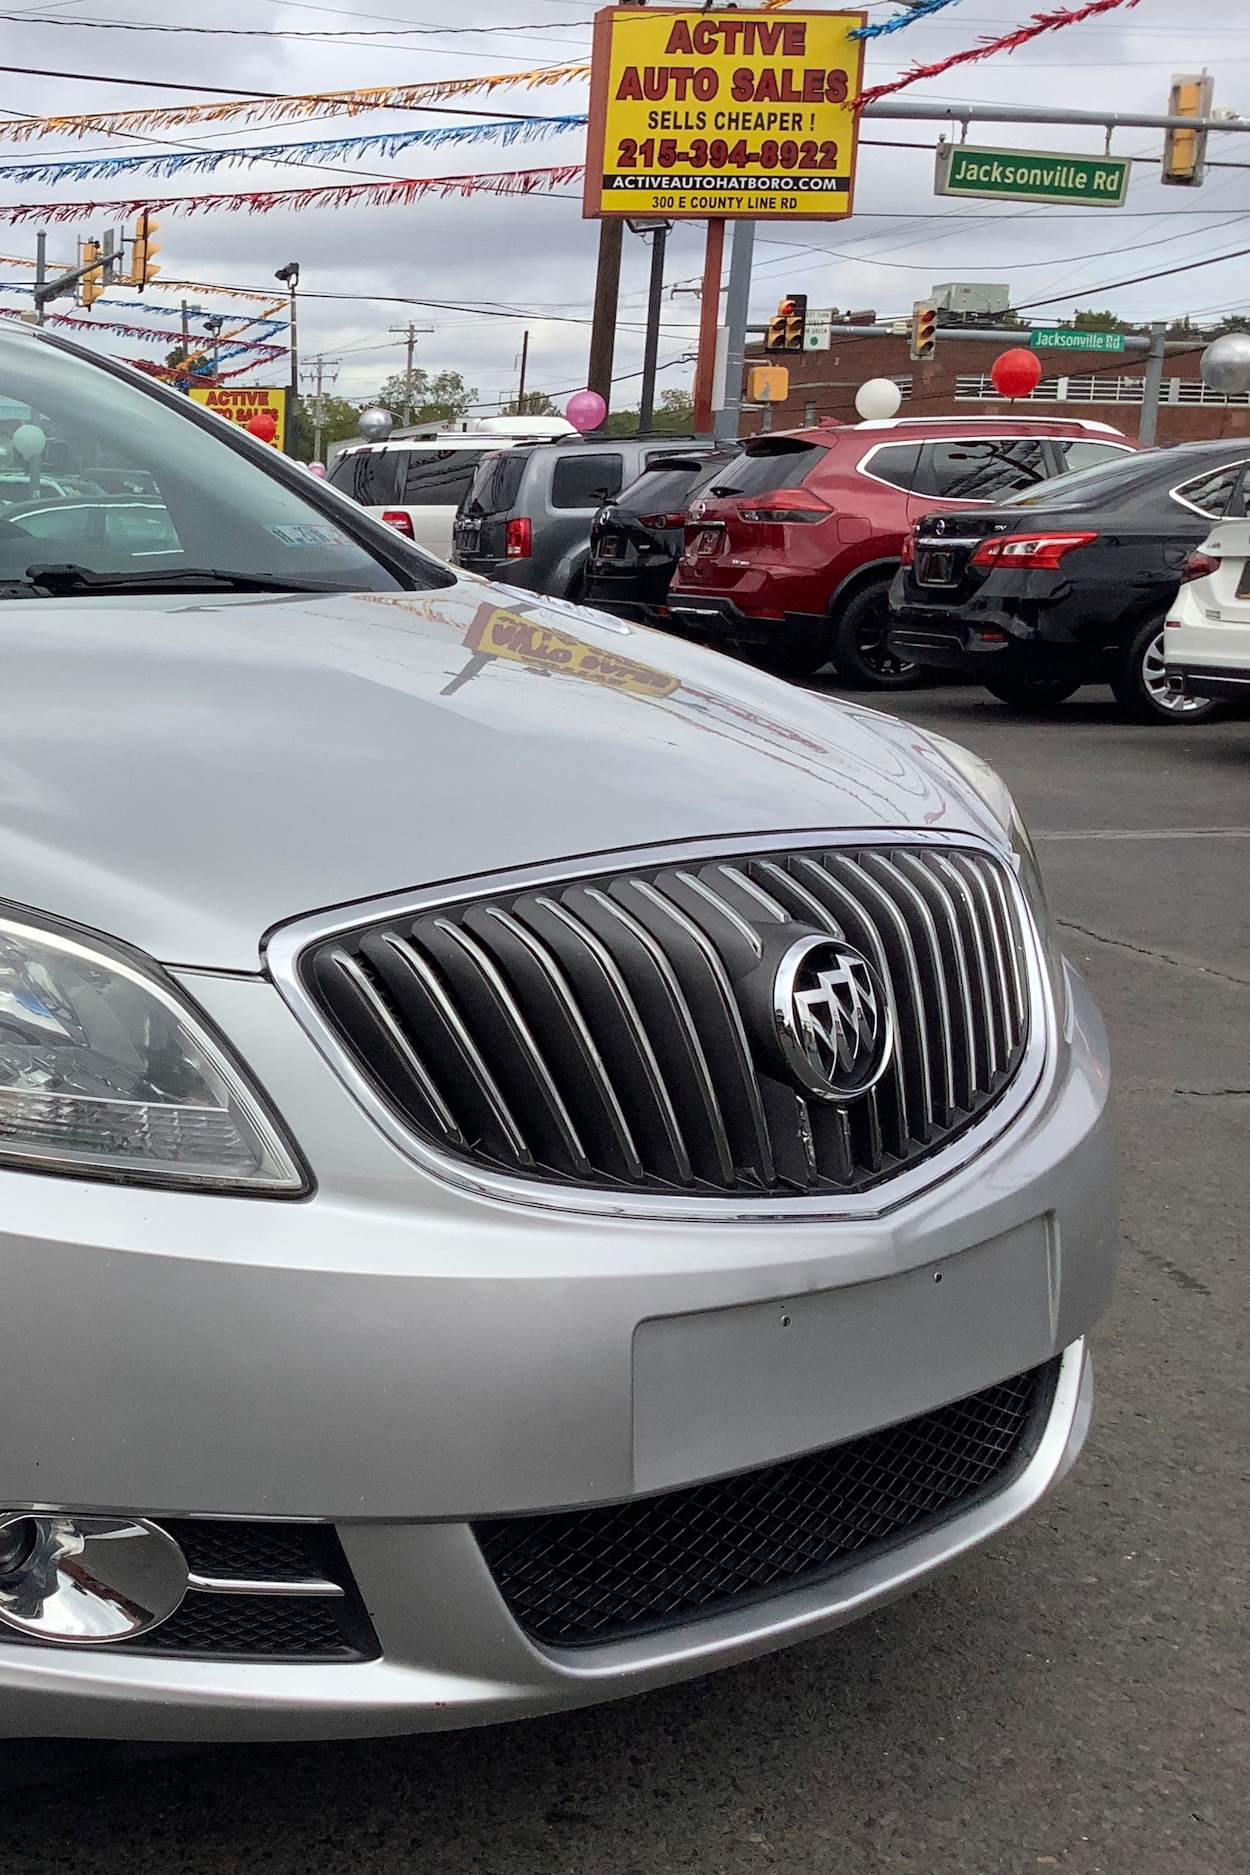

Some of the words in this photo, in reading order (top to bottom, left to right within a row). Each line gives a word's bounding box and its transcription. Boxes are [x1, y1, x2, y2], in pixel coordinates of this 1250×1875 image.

[664, 20, 807, 56] ACTIVE
[615, 66, 719, 102] AUTO
[730, 67, 849, 103] SALES
[648, 111, 707, 130] SELLS
[714, 111, 803, 131] CHEAPER
[810, 113, 816, 131] !
[616, 138, 838, 170] 215-394-8922
[612, 176, 837, 190] ACTIVEAUTOHATBORO.COM
[955, 160, 1088, 189] Jacksonville
[1093, 170, 1120, 192] Rd
[652, 196, 674, 208] 300
[678, 197, 686, 209] E
[690, 197, 743, 209] COUNTY
[747, 197, 777, 209] LINE
[780, 197, 797, 209] RD
[1035, 332, 1103, 348] Jacksonville
[1106, 335, 1120, 349] Rd
[206, 391, 269, 406] ACTIVE
[211, 408, 233, 421] TO
